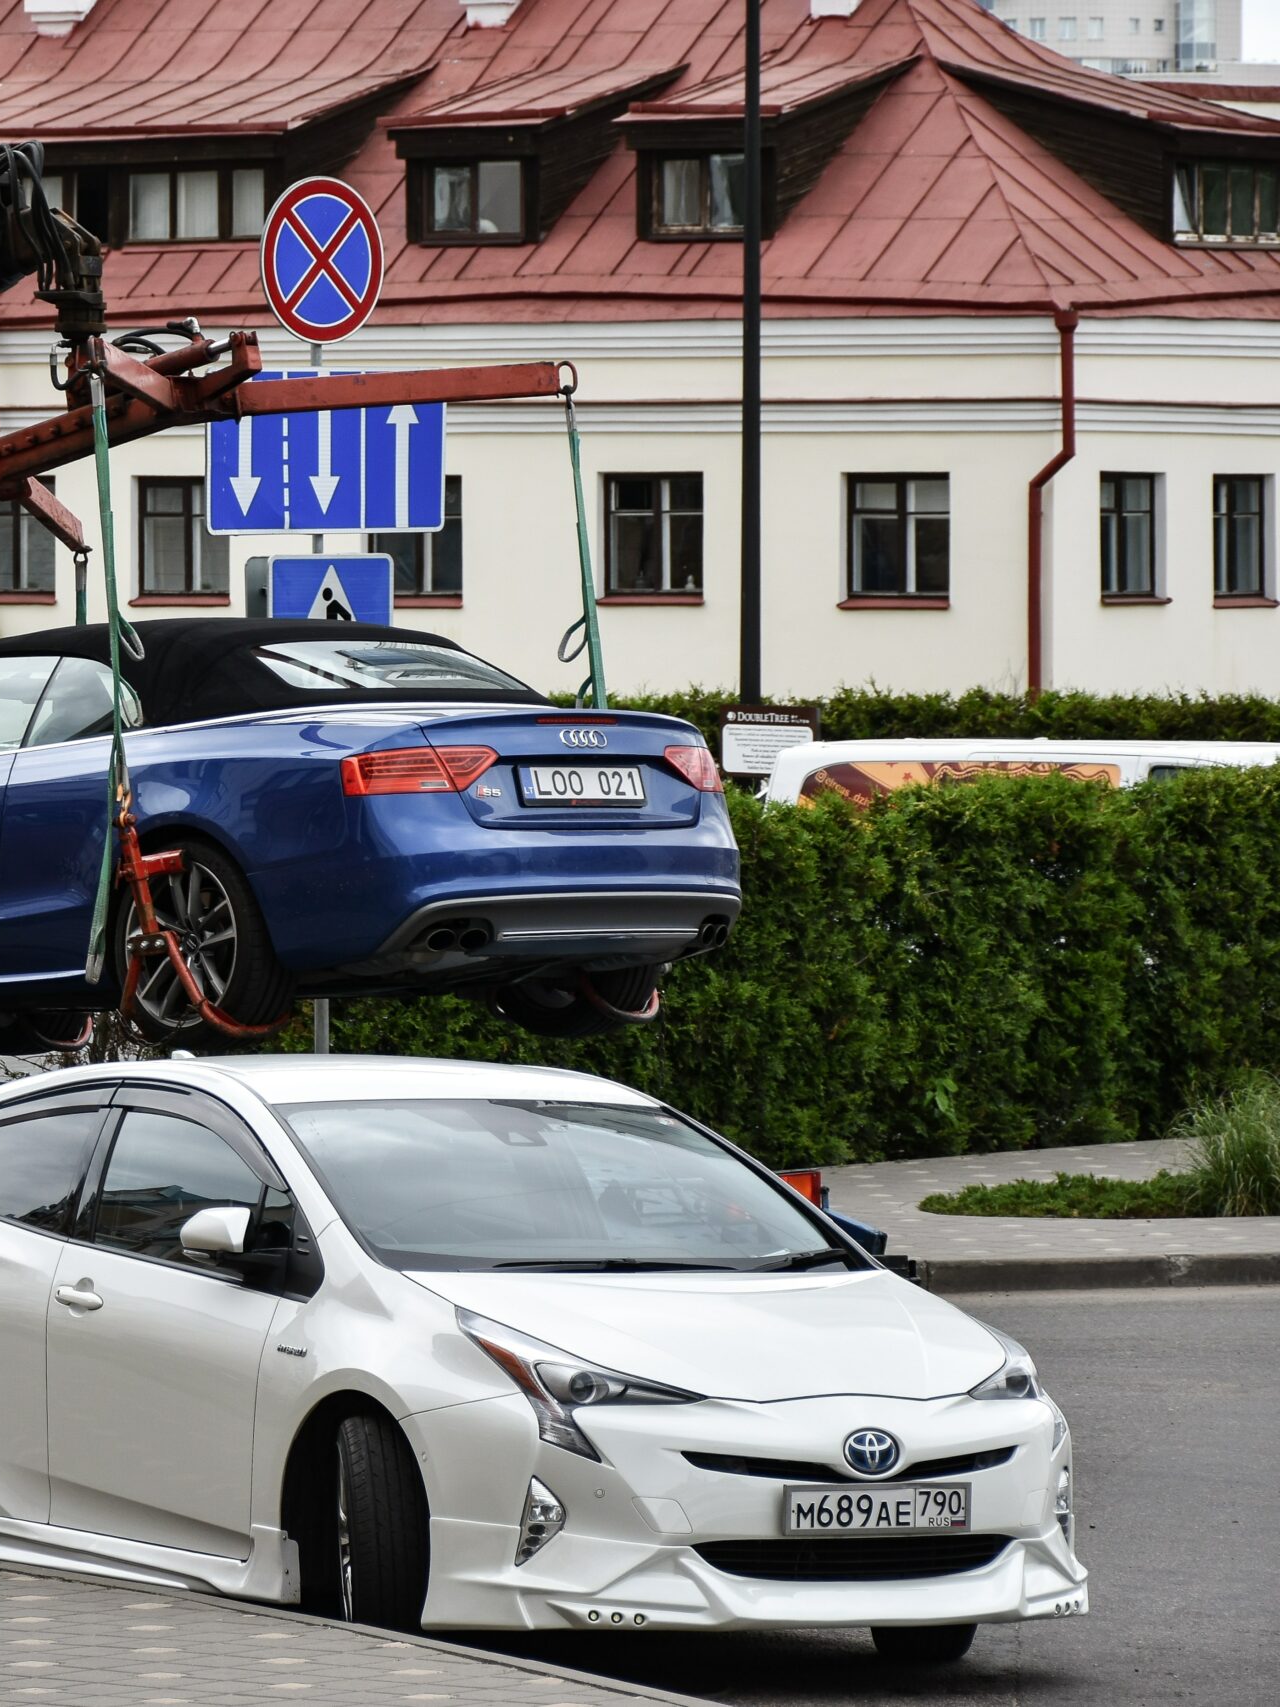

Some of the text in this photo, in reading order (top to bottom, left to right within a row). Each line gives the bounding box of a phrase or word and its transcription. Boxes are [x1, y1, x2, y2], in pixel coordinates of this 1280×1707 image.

[533, 769, 638, 796] LOO 021
[796, 1490, 962, 1529] M689AE 790
[928, 1516, 950, 1527] RUS
